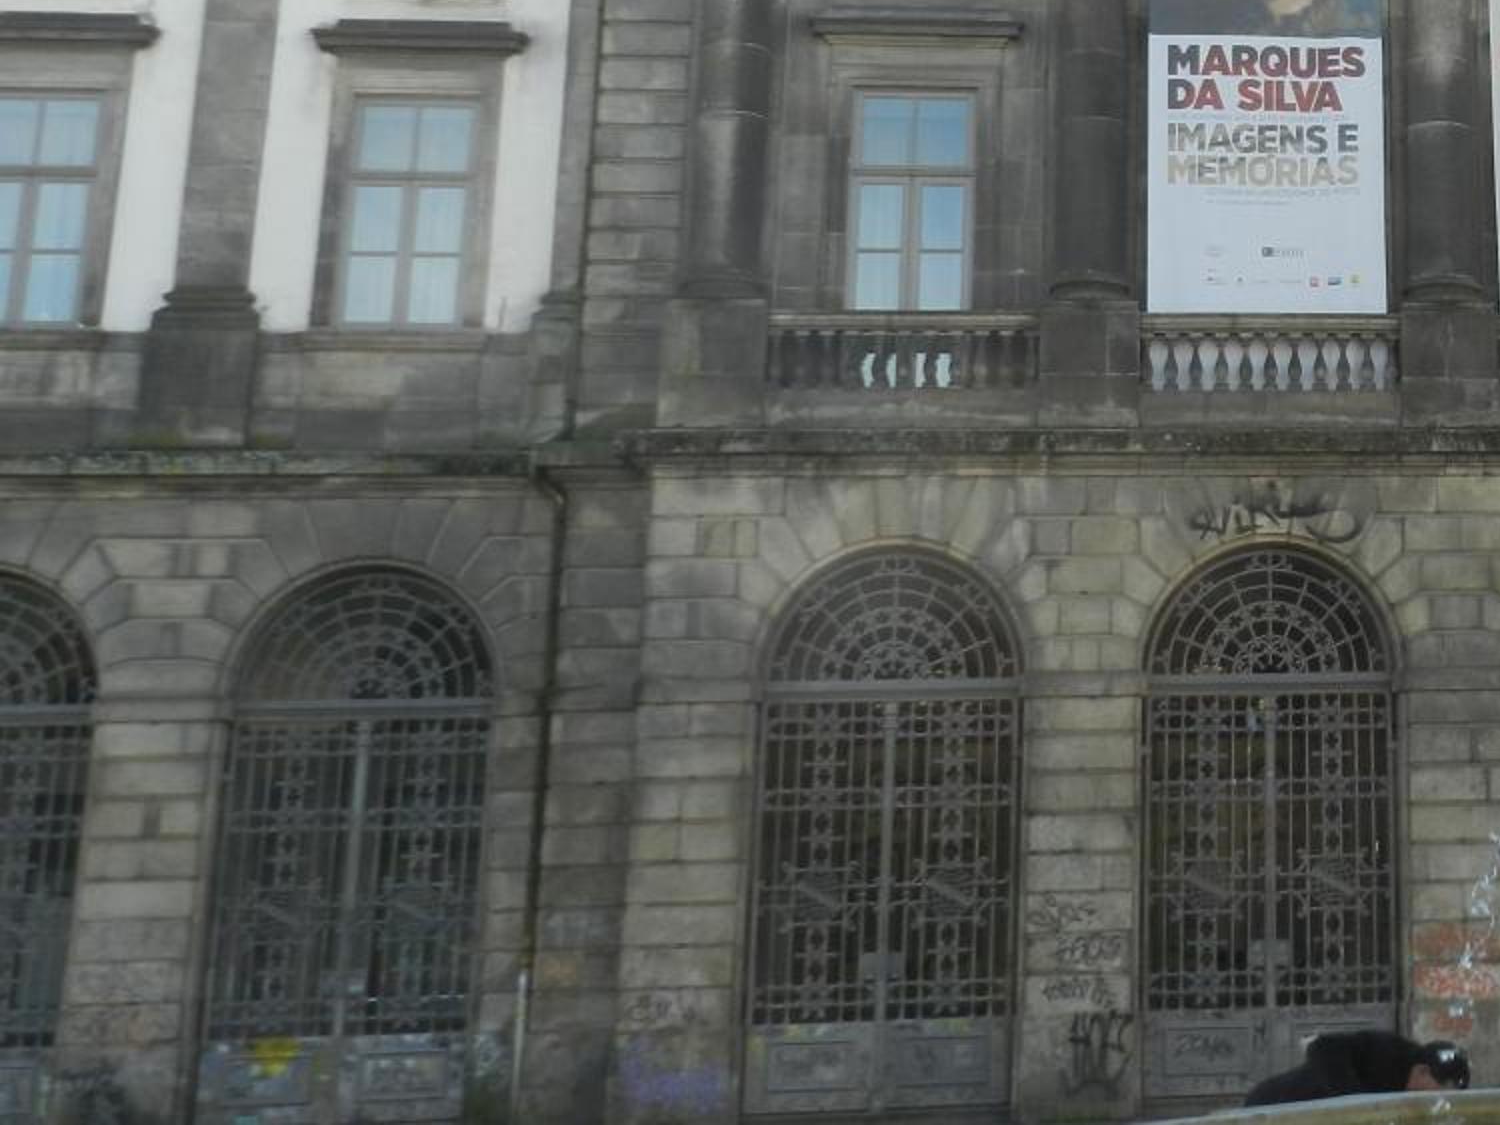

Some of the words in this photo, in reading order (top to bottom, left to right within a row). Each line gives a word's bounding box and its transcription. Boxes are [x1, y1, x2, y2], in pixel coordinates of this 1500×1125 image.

[1167, 44, 1366, 79] MARQUES
[1167, 78, 1224, 110] DA
[1237, 79, 1343, 112] SILVA
[1167, 123, 1328, 154] IMAGENS
[1338, 124, 1359, 153] E
